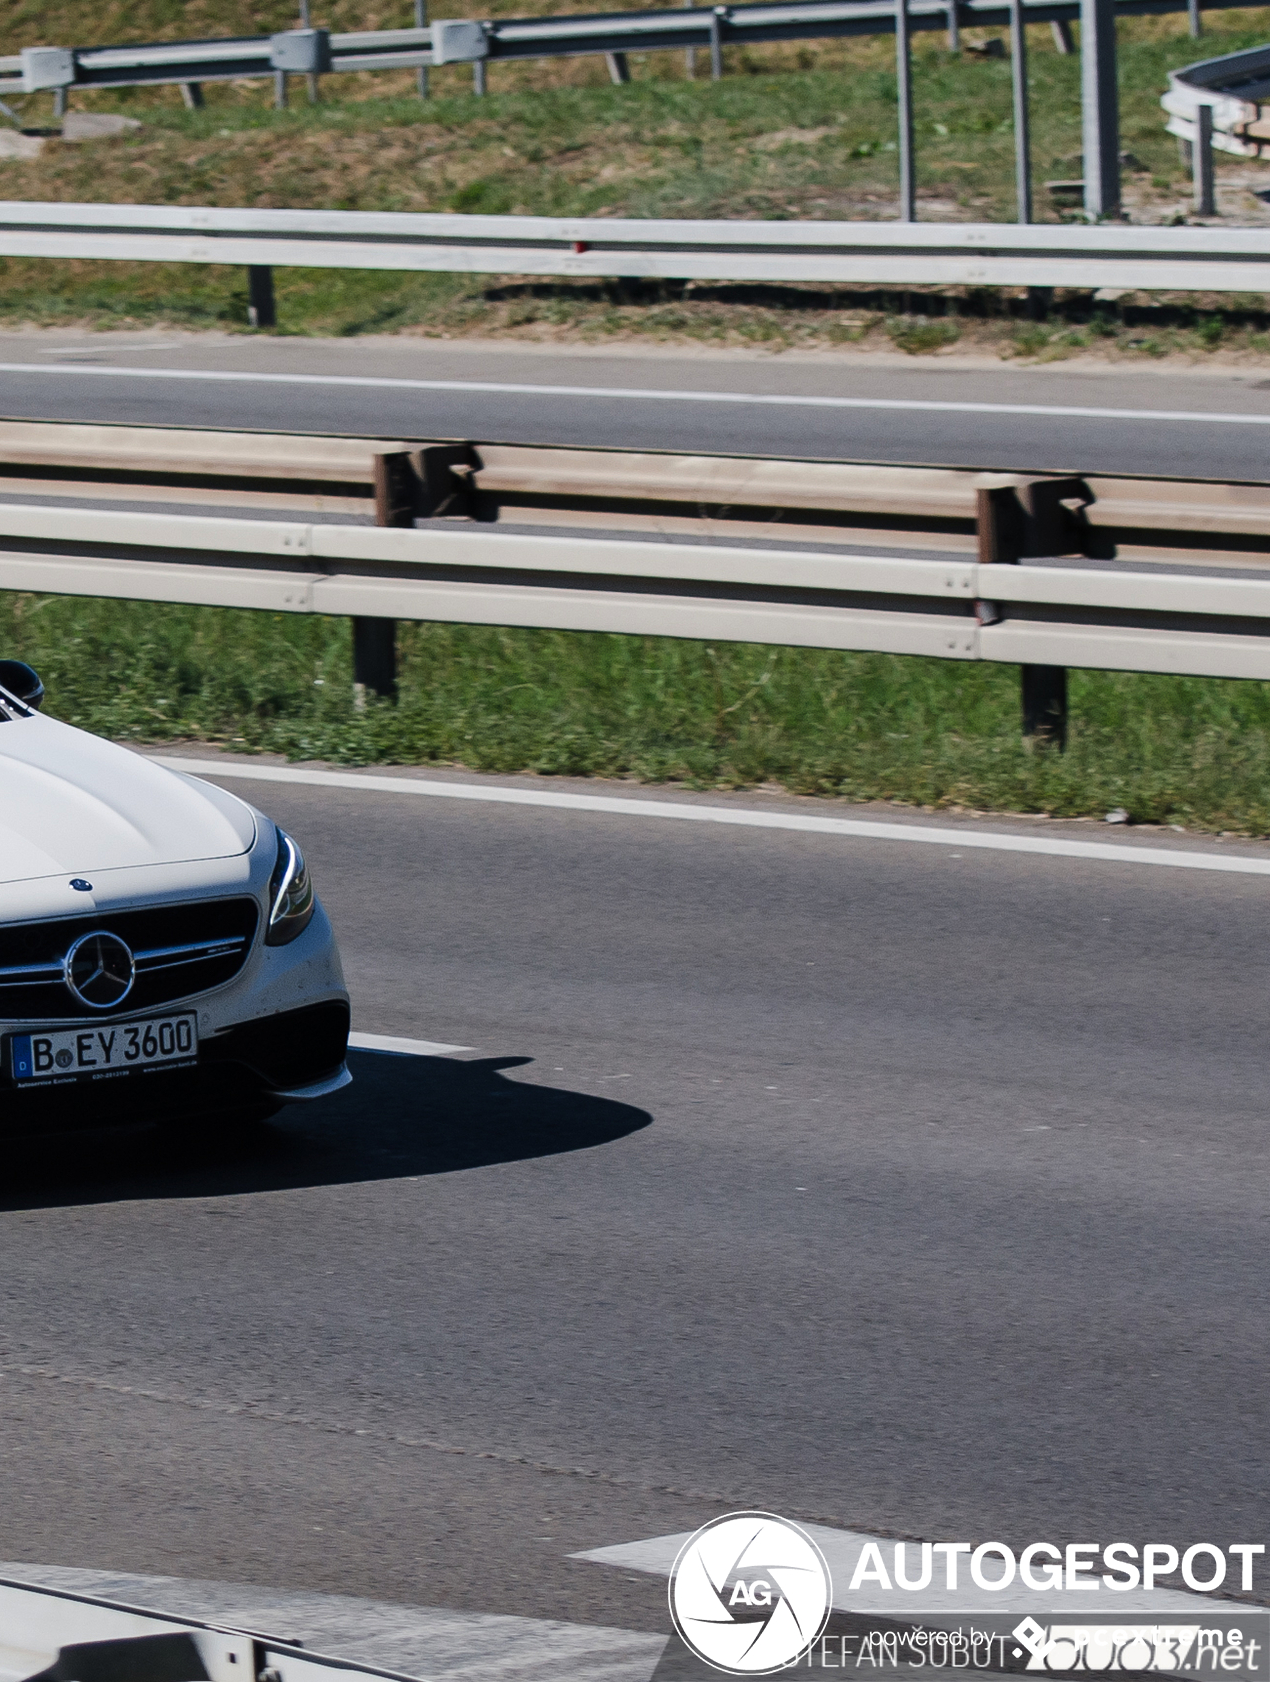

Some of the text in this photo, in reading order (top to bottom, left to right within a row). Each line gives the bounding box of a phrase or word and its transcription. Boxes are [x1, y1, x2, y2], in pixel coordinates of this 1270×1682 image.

[33, 1019, 192, 1072] B EY 3600
[19, 1061, 27, 1071] D
